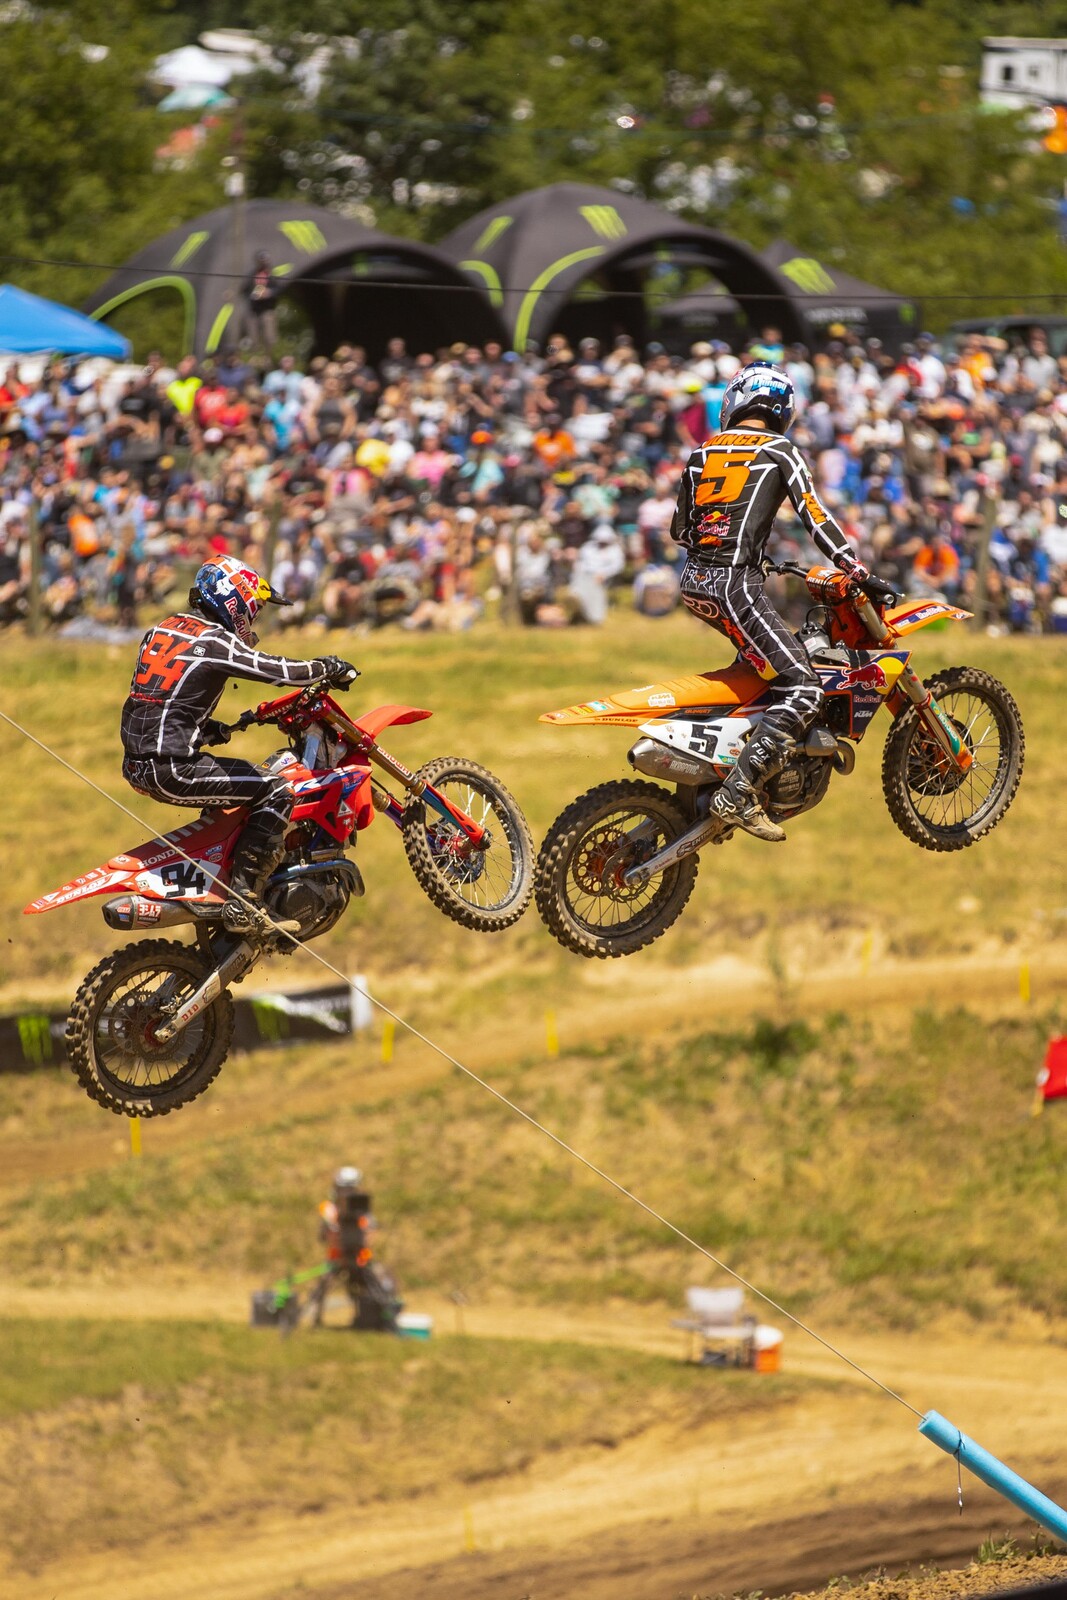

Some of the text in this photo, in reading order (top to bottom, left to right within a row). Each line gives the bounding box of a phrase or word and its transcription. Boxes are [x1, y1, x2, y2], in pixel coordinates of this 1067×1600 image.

[695, 452, 758, 506] 5
[135, 633, 194, 691] 94
[853, 710, 874, 719] KTM
[688, 723, 723, 760] 5
[751, 742, 771, 761] FOX
[171, 798, 232, 806] HONDA
[136, 845, 186, 870] HONDA
[160, 859, 206, 899] 94
[181, 1003, 200, 1022] DID
